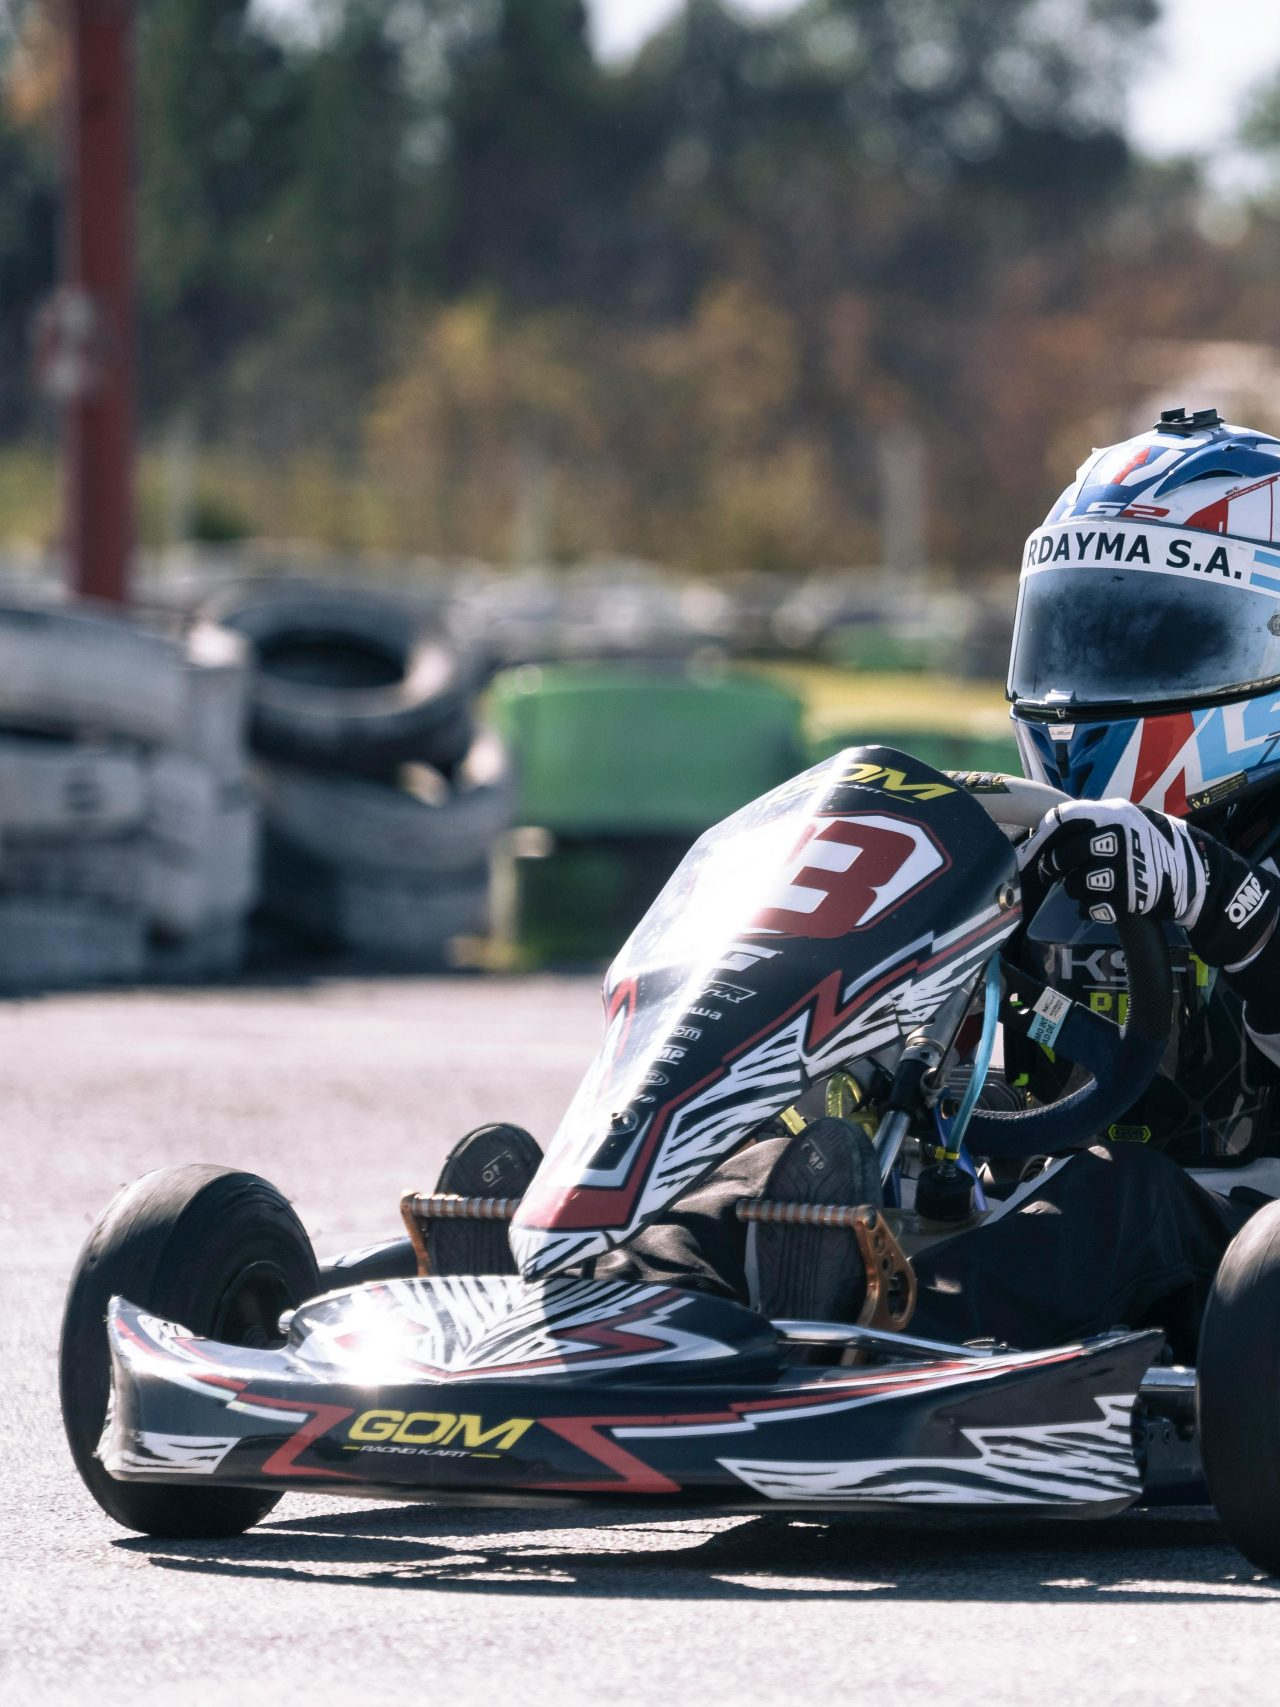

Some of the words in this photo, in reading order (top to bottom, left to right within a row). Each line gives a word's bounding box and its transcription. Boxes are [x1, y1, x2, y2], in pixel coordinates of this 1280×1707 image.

[1165, 539, 1243, 580] S.A.
[747, 819, 917, 939] 3
[1228, 876, 1264, 924] OMP
[348, 1409, 536, 1450] GOM
[360, 1445, 417, 1455] RACING
[417, 1448, 471, 1458] KART
